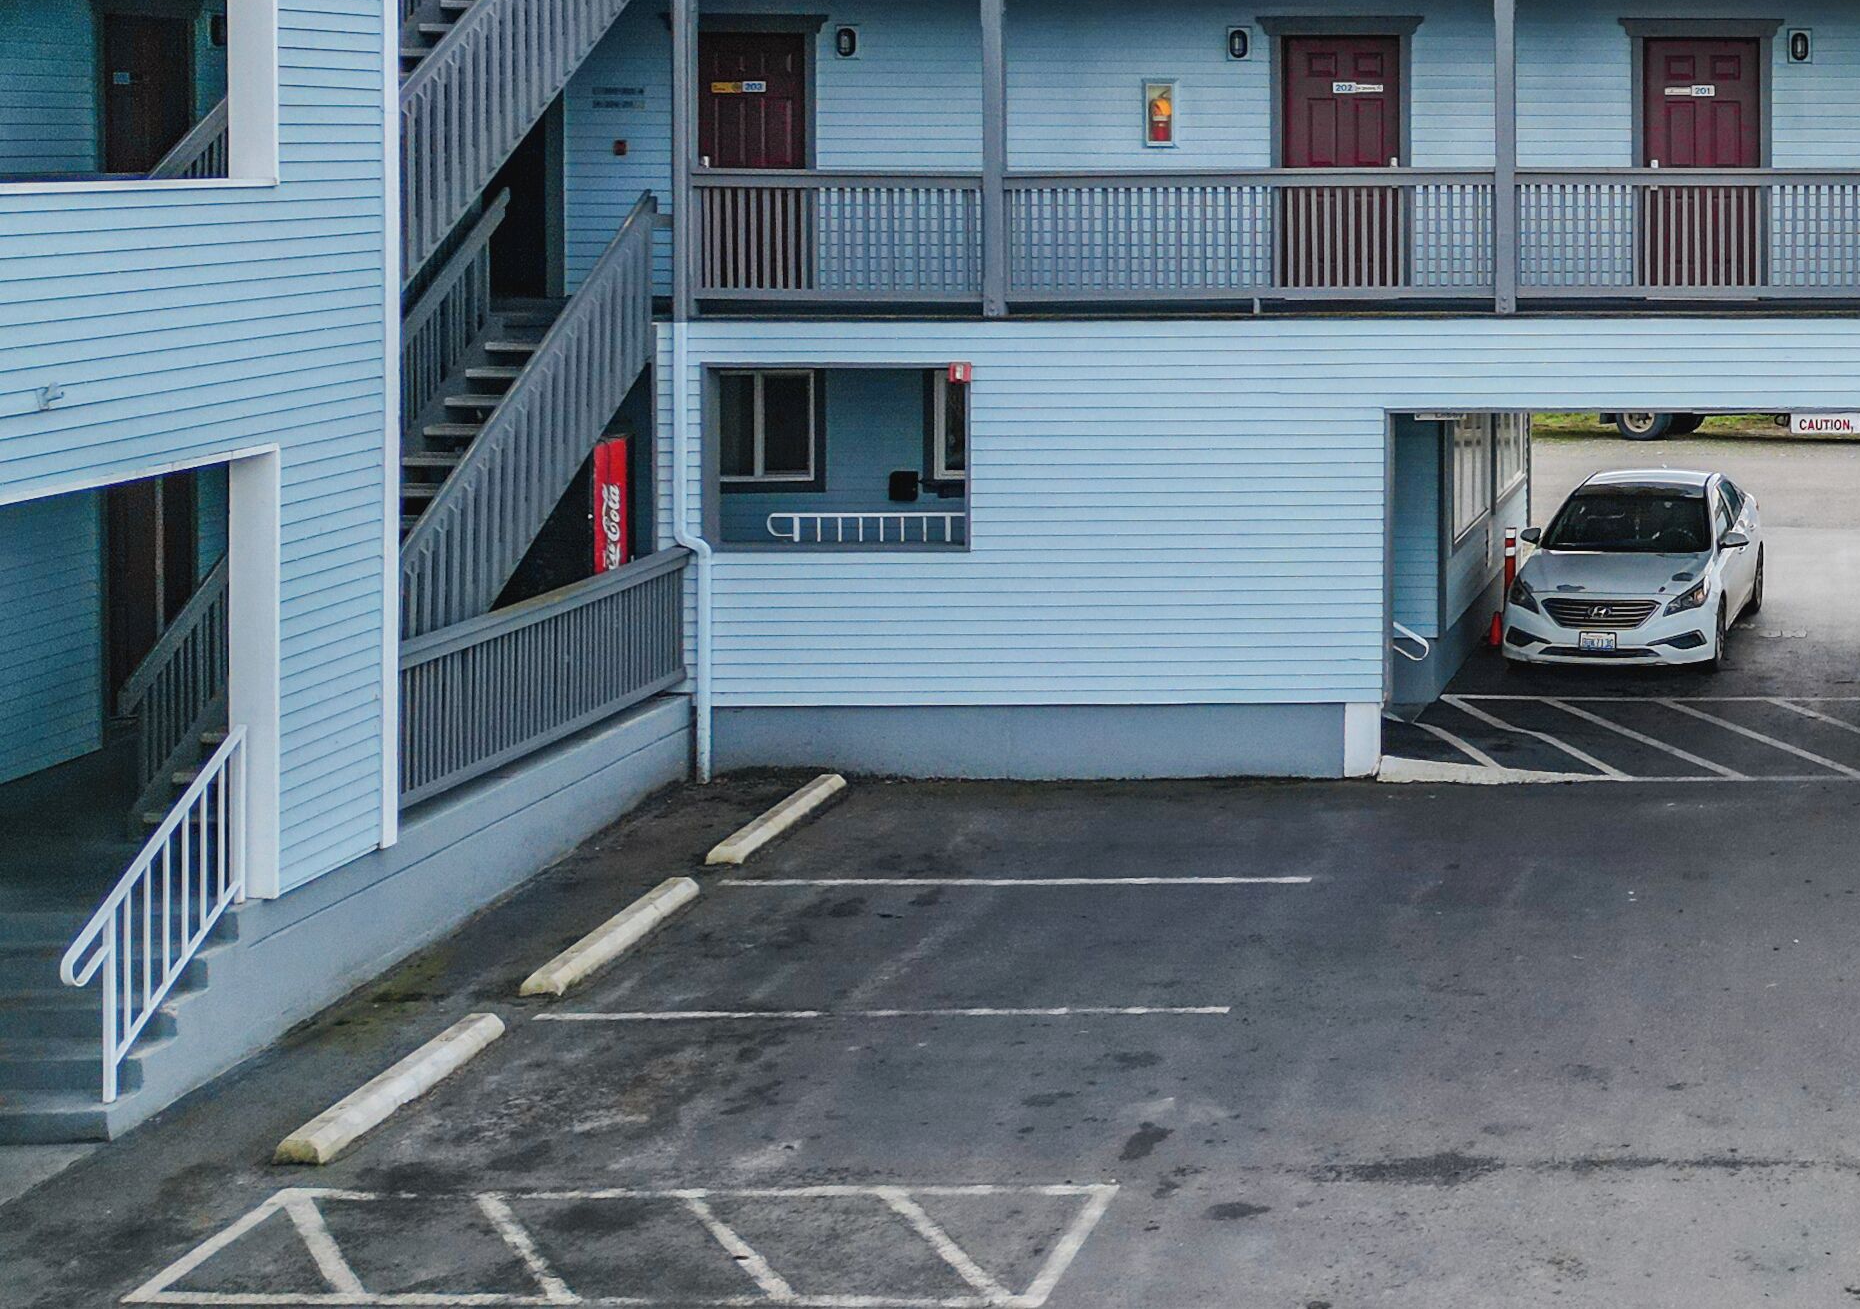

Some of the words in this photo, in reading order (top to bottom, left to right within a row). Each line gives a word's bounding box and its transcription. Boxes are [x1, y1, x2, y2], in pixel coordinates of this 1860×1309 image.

[1335, 84, 1353, 92] 202
[1695, 87, 1711, 95] 201
[1799, 419, 1854, 433] CAUTION,
